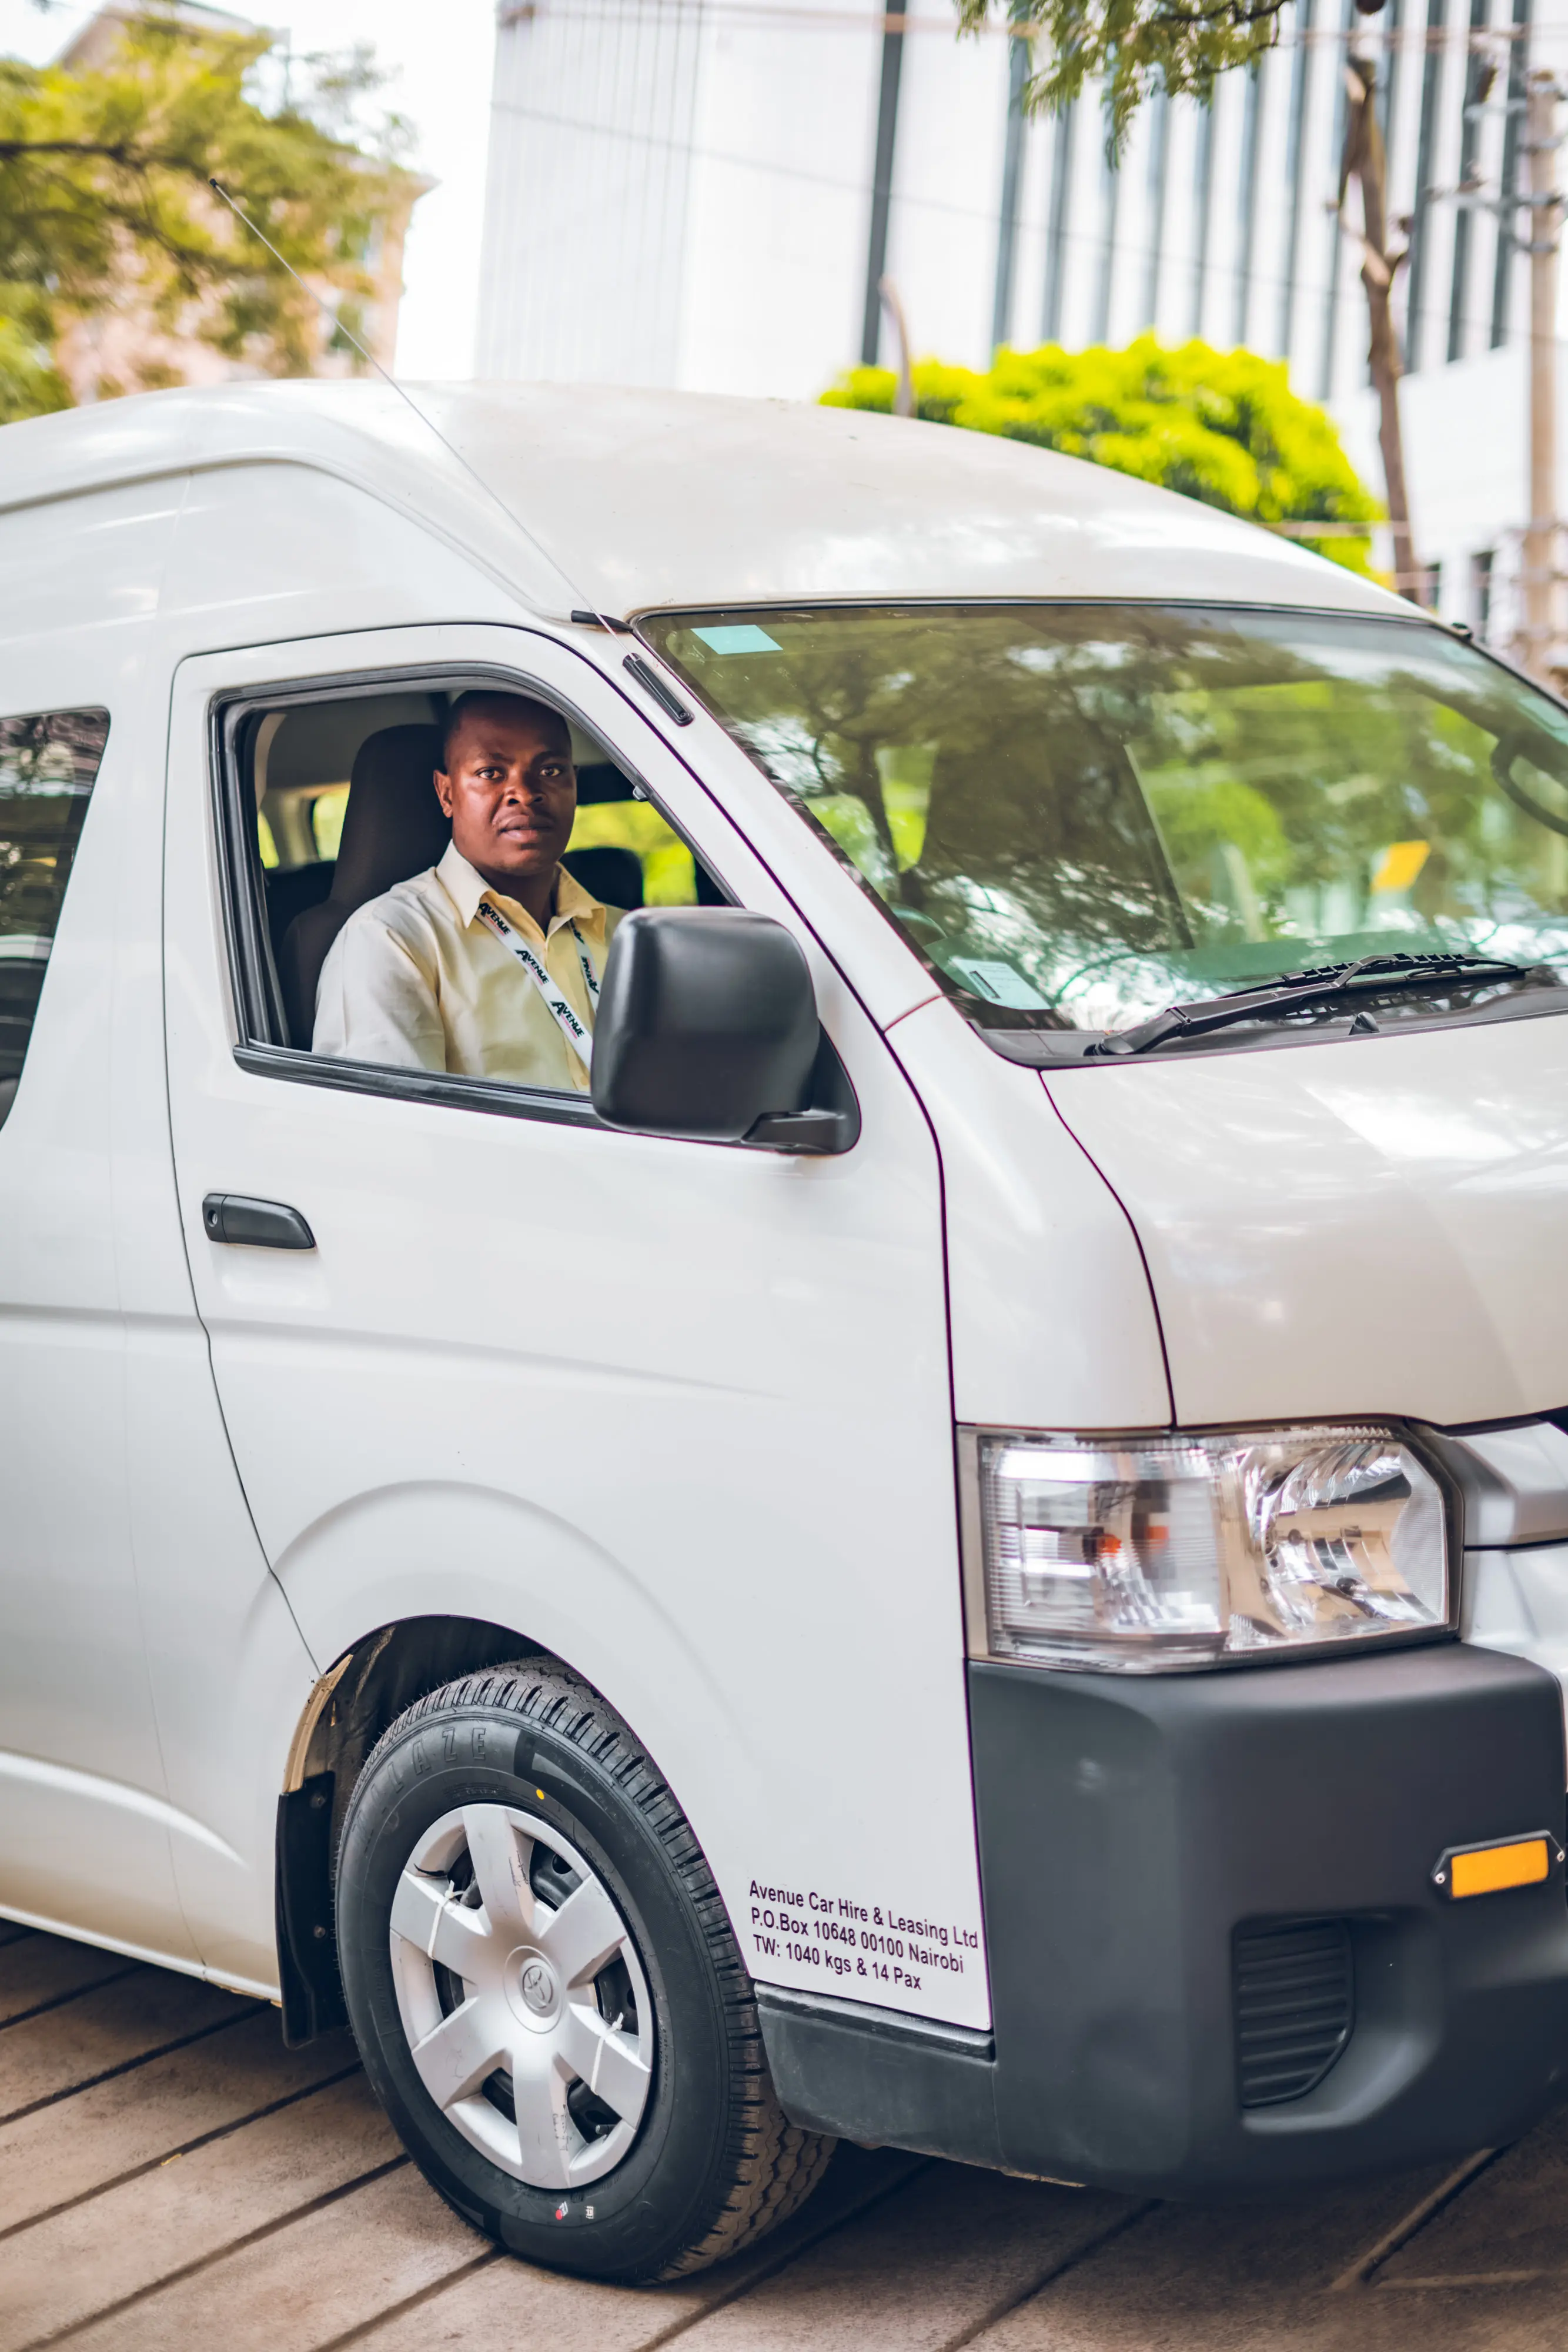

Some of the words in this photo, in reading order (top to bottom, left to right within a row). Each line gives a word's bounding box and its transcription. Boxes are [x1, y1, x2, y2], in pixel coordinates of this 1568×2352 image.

[478, 902, 511, 935] AVENUE
[514, 950, 549, 984] AVENUE
[550, 1001, 584, 1037] AVENUE
[749, 1880, 804, 1907] Avenue
[808, 1892, 834, 1914] Car
[838, 1898, 868, 1922] Hire
[873, 1906, 884, 1926] &
[888, 1910, 948, 1946] Leasing
[953, 1926, 978, 1949] Ltd
[751, 1906, 809, 1936] P.O.Box
[813, 1920, 857, 1947] 10648
[860, 1931, 904, 1958] 00100
[908, 1942, 964, 1973] Nairobi
[753, 1933, 781, 1957] TW:
[785, 1942, 820, 1966] 1040
[824, 1949, 852, 1976] kgs
[856, 1957, 868, 1977] &
[872, 1962, 890, 1982] 14
[893, 1966, 922, 1990] Pax
